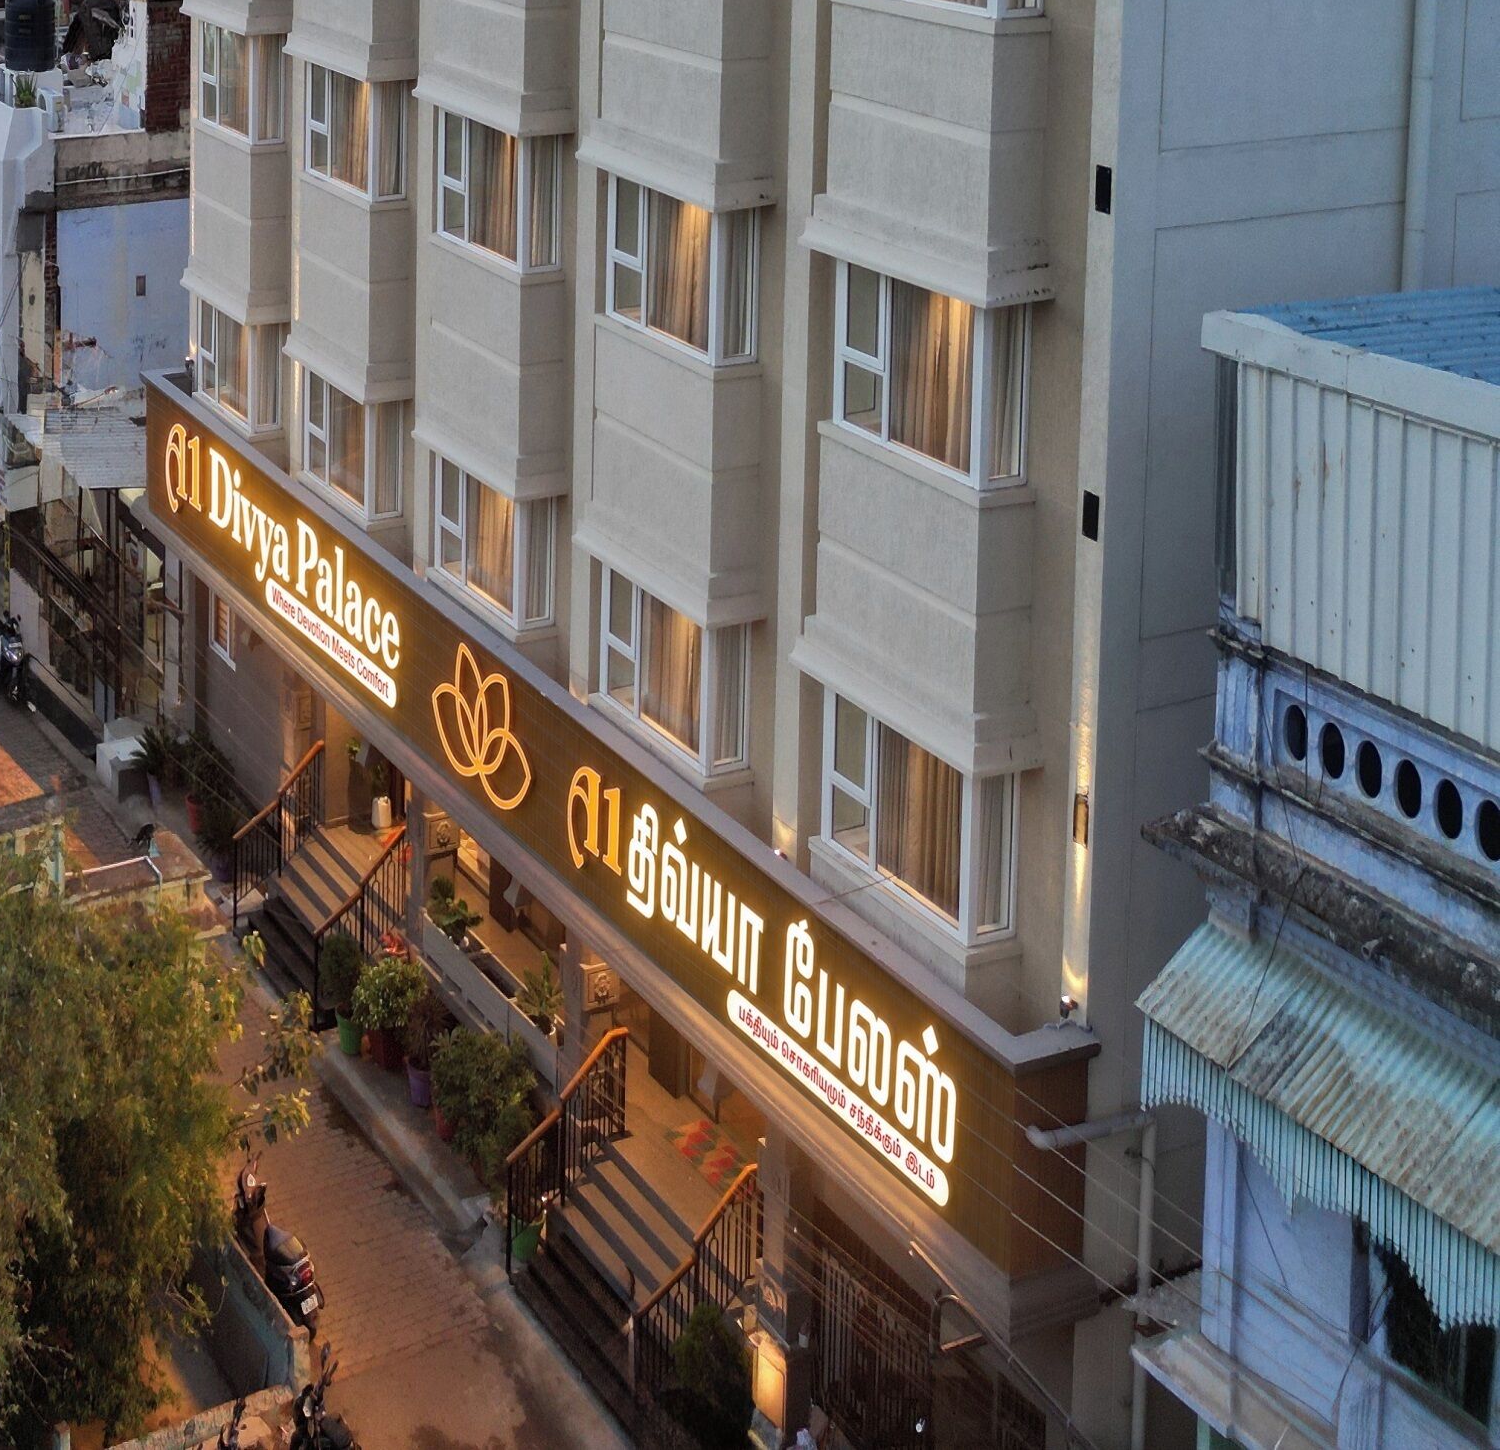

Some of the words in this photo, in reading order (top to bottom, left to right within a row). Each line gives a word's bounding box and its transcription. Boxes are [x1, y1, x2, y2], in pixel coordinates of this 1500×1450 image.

[208, 447, 290, 582] Divya
[296, 518, 400, 670] Palace
[271, 586, 296, 620] Where
[297, 607, 330, 649] Devotion
[332, 635, 355, 669] Meets
[356, 658, 389, 699] Comfort
[626, 802, 764, 996] திவ்யா
[783, 920, 957, 1164] பேலஸ்
[739, 1005, 779, 1051] பக்தியும்
[849, 1103, 902, 1159] சந்திக்கும்
[905, 1151, 935, 1190] இடம்
